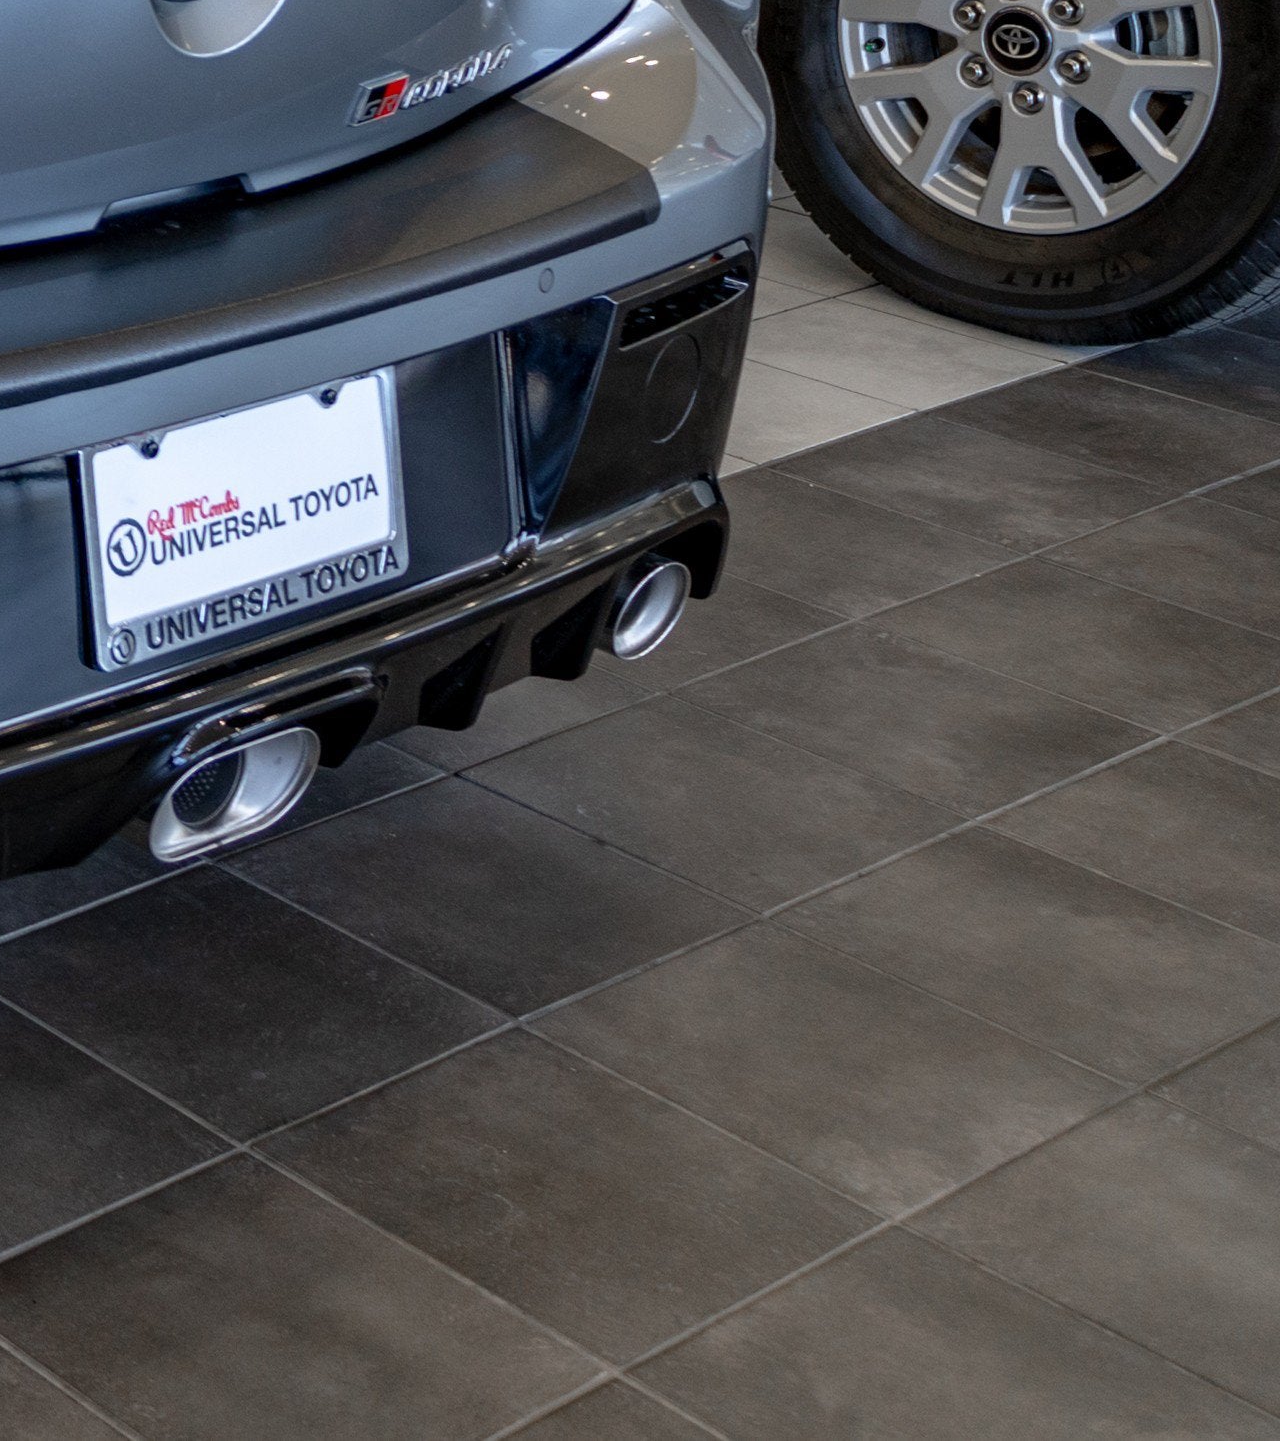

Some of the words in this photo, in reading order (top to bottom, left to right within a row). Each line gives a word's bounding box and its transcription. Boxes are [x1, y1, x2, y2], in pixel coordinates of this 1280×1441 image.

[997, 270, 1076, 288] HLT
[147, 506, 175, 538] Red
[149, 503, 286, 566] UNIVERSAL
[289, 474, 379, 521] TOYOTA
[145, 577, 298, 650] UNIVERSAL
[300, 545, 399, 598] TOYOTA
